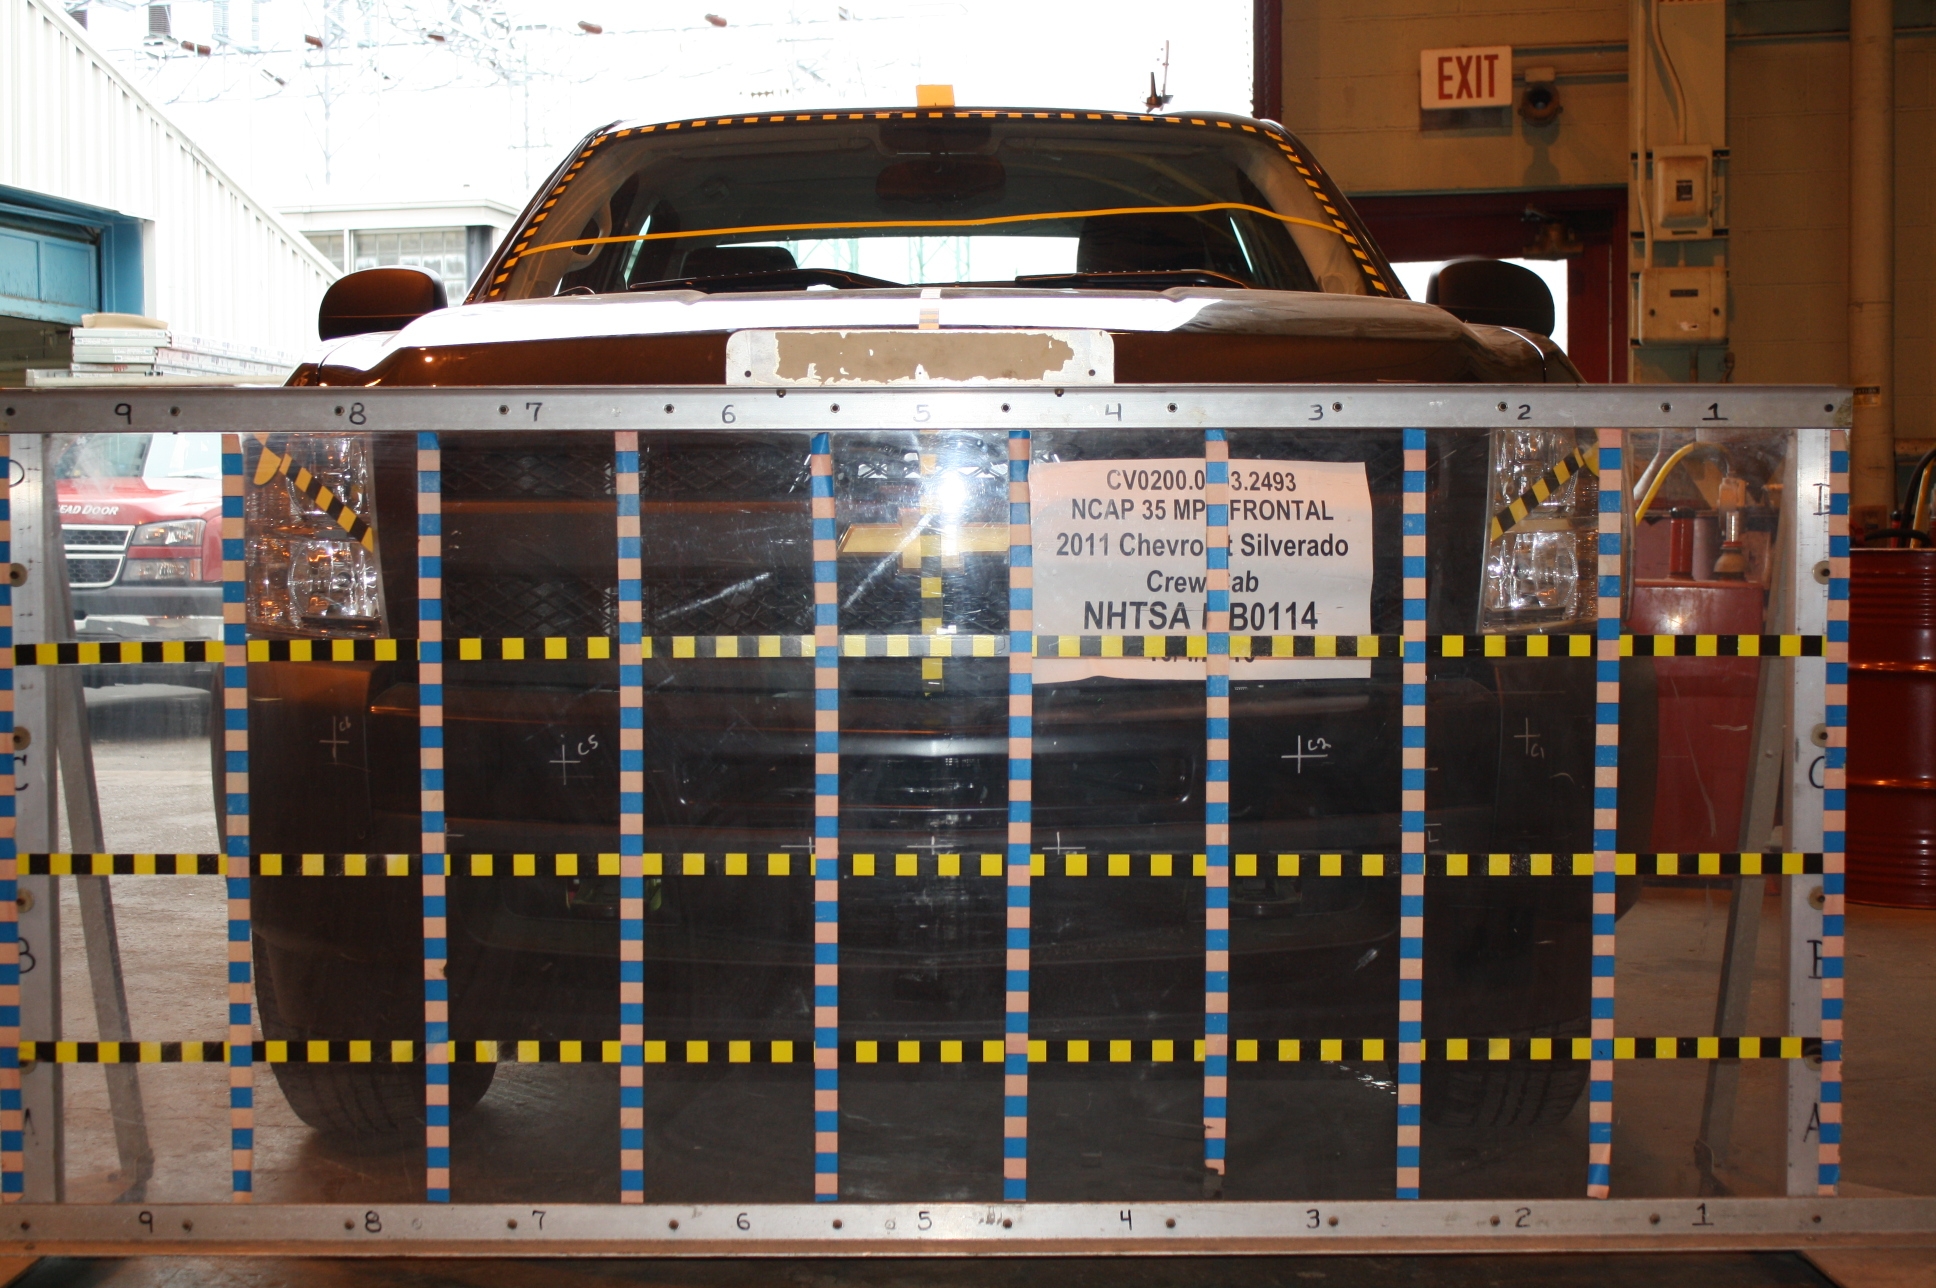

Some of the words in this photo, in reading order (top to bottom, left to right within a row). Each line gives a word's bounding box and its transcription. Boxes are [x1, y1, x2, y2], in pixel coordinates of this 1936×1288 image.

[1437, 54, 1499, 100] EXIT
[115, 403, 132, 425] 9
[348, 403, 367, 426] 8
[525, 402, 543, 422] 7
[722, 404, 736, 424] 6
[912, 404, 931, 423] 5
[1104, 403, 1122, 422] 4
[1308, 404, 1324, 421] 3
[1517, 404, 1532, 421] 2
[1702, 402, 1728, 421] 1
[1106, 469, 1297, 492] CV0200.03.2493
[1071, 498, 1134, 520] NCAP
[1142, 499, 1166, 520] 35
[1230, 499, 1334, 521] FRONTAL
[1056, 532, 1109, 556] 2011
[1240, 533, 1349, 557] Silverado
[1146, 570, 1207, 593] Crew
[1083, 600, 1191, 630] NHTSA
[138, 1211, 153, 1233] 9
[364, 1210, 382, 1234] 8
[531, 1210, 546, 1230] 7
[736, 1212, 751, 1231] 6
[918, 1210, 933, 1230] 5
[1119, 1209, 1133, 1230] 4
[1306, 1208, 1320, 1228] 3
[1514, 1207, 1532, 1228] 2
[1691, 1203, 1714, 1226] 1
